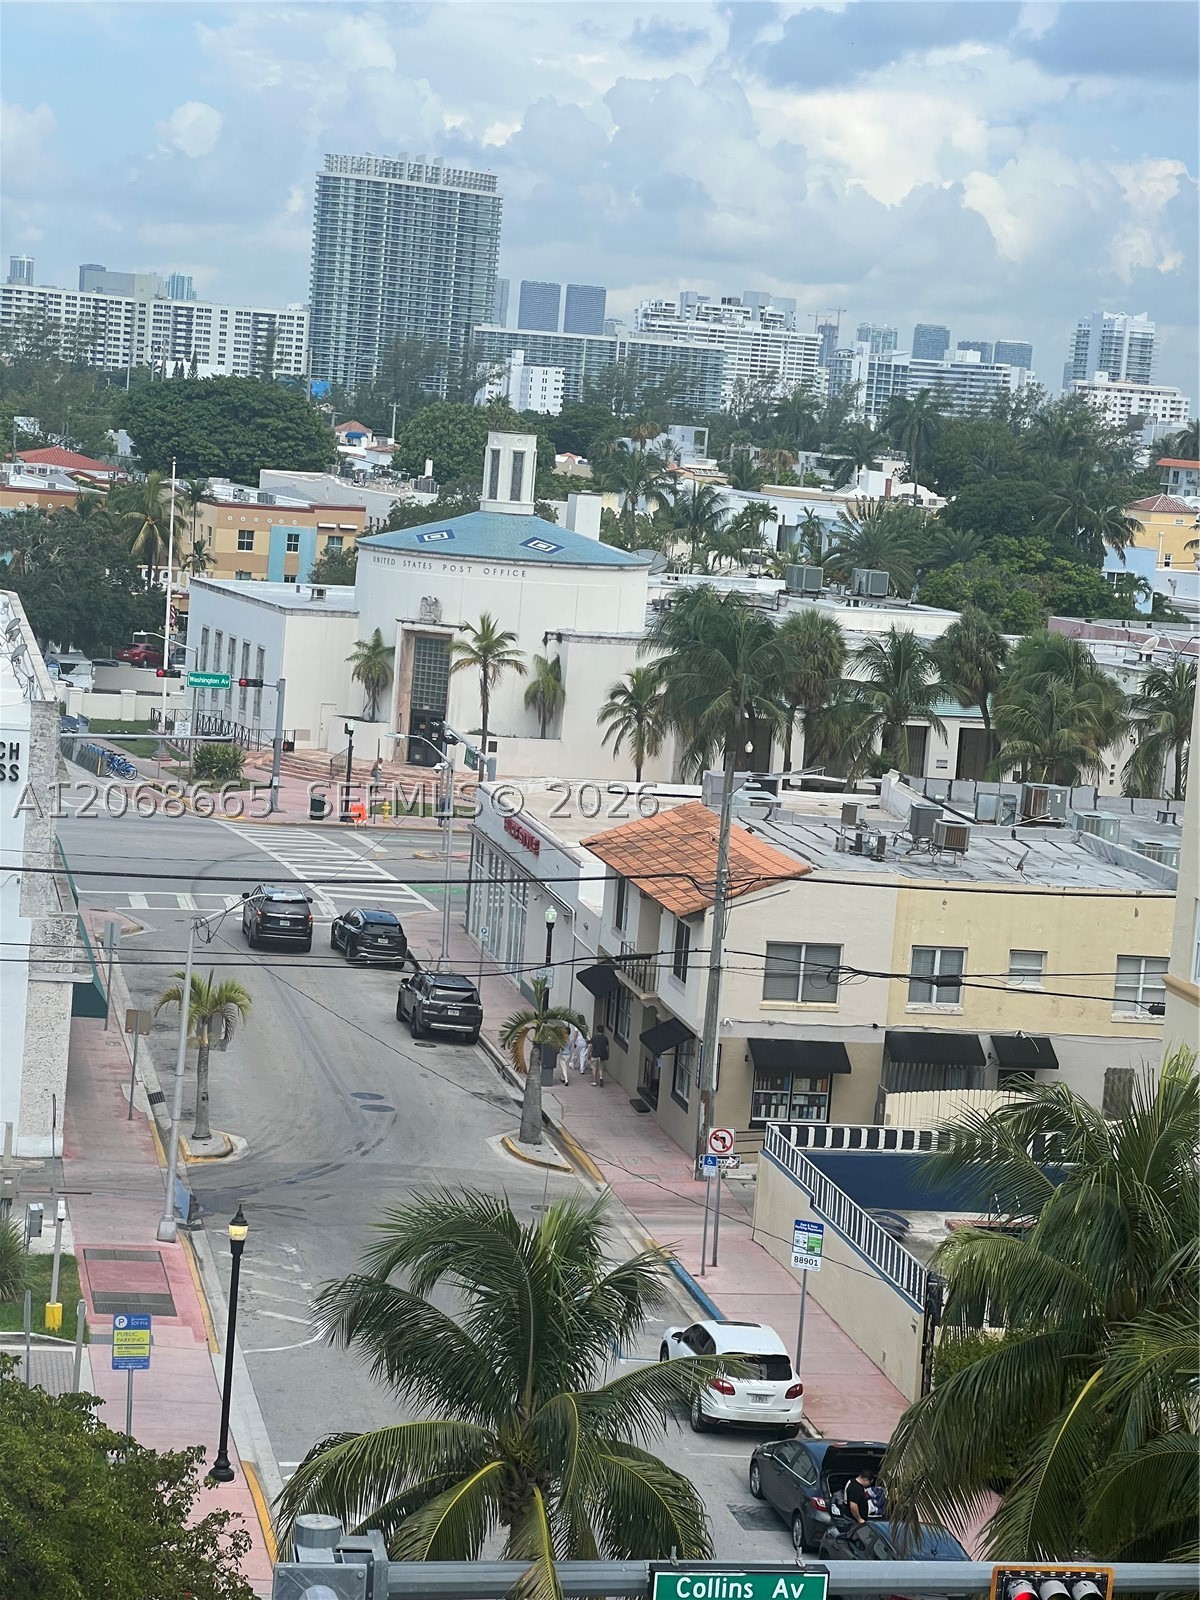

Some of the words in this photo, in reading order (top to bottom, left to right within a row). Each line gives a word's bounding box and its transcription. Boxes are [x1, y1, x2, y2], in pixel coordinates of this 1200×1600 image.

[372, 556, 396, 566] UNITED
[402, 560, 433, 570] STATES
[442, 564, 473, 574] POST
[483, 567, 527, 578] OFFICE
[189, 676, 219, 685] Washington
[793, 1255, 818, 1267] 88901
[676, 1577, 753, 1599] Collins
[771, 1578, 805, 1599] Av
